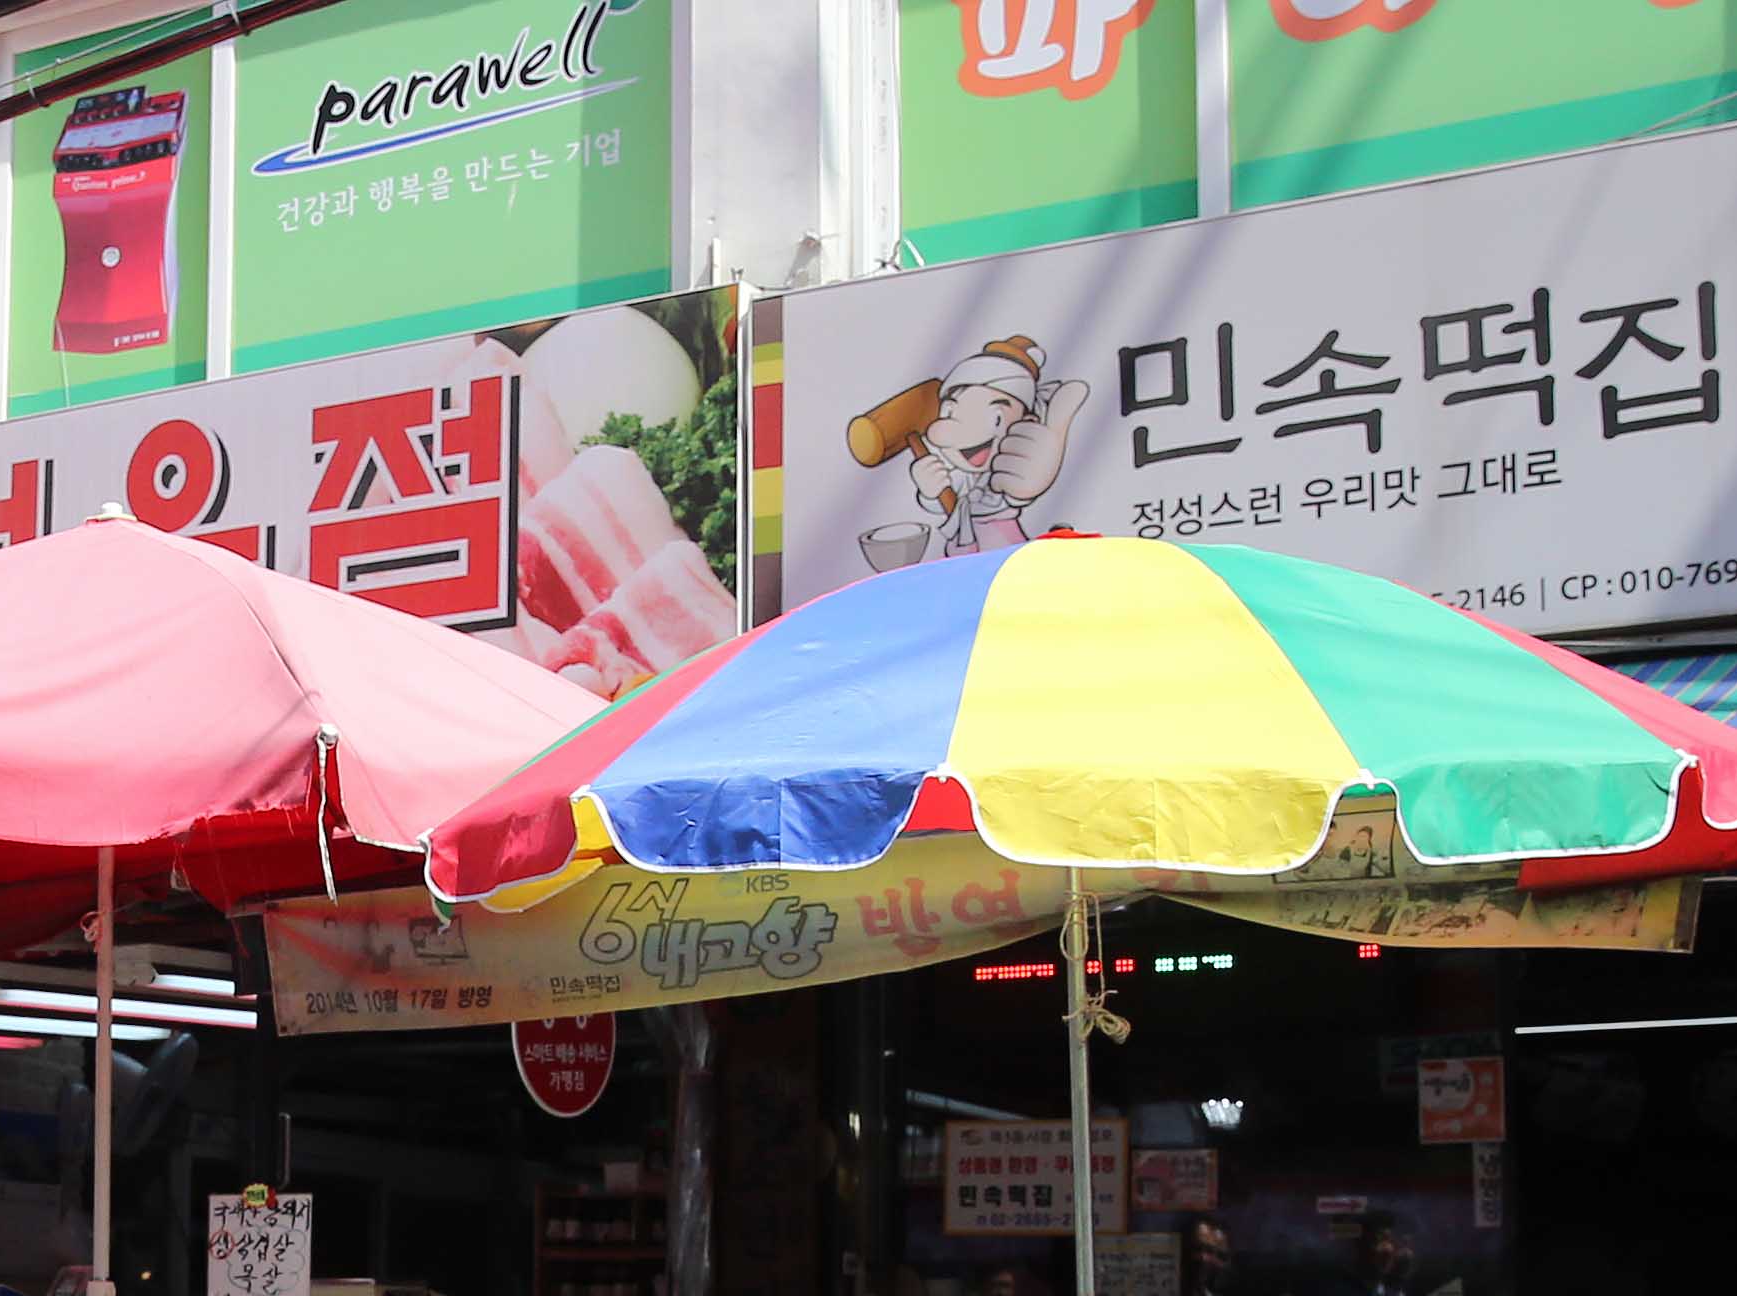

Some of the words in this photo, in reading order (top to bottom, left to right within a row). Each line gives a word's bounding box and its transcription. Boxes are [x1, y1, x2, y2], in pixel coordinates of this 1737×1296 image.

[310, 2, 605, 153] parawell
[275, 187, 358, 234] 건강과
[368, 168, 453, 213] 행복을
[464, 146, 555, 192] 만드는
[565, 129, 623, 169] 기업
[1116, 280, 1720, 470] 민속떡집
[1131, 486, 1284, 540] 정성스런
[1299, 465, 1422, 520] 우리맛
[1436, 448, 1564, 500] 그대로
[745, 873, 791, 894] KBS
[641, 896, 840, 990] 내고향
[549, 965, 622, 995] 민속떡집
[306, 990, 359, 1016] 2014년
[364, 988, 399, 1013] 10월
[409, 987, 447, 1010] 17일
[548, 1069, 585, 1092] 가맹점
[958, 1184, 1053, 1208] 민속떡집
[237, 1232, 295, 1262] 삼겹살
[234, 1263, 283, 1296] 목살
